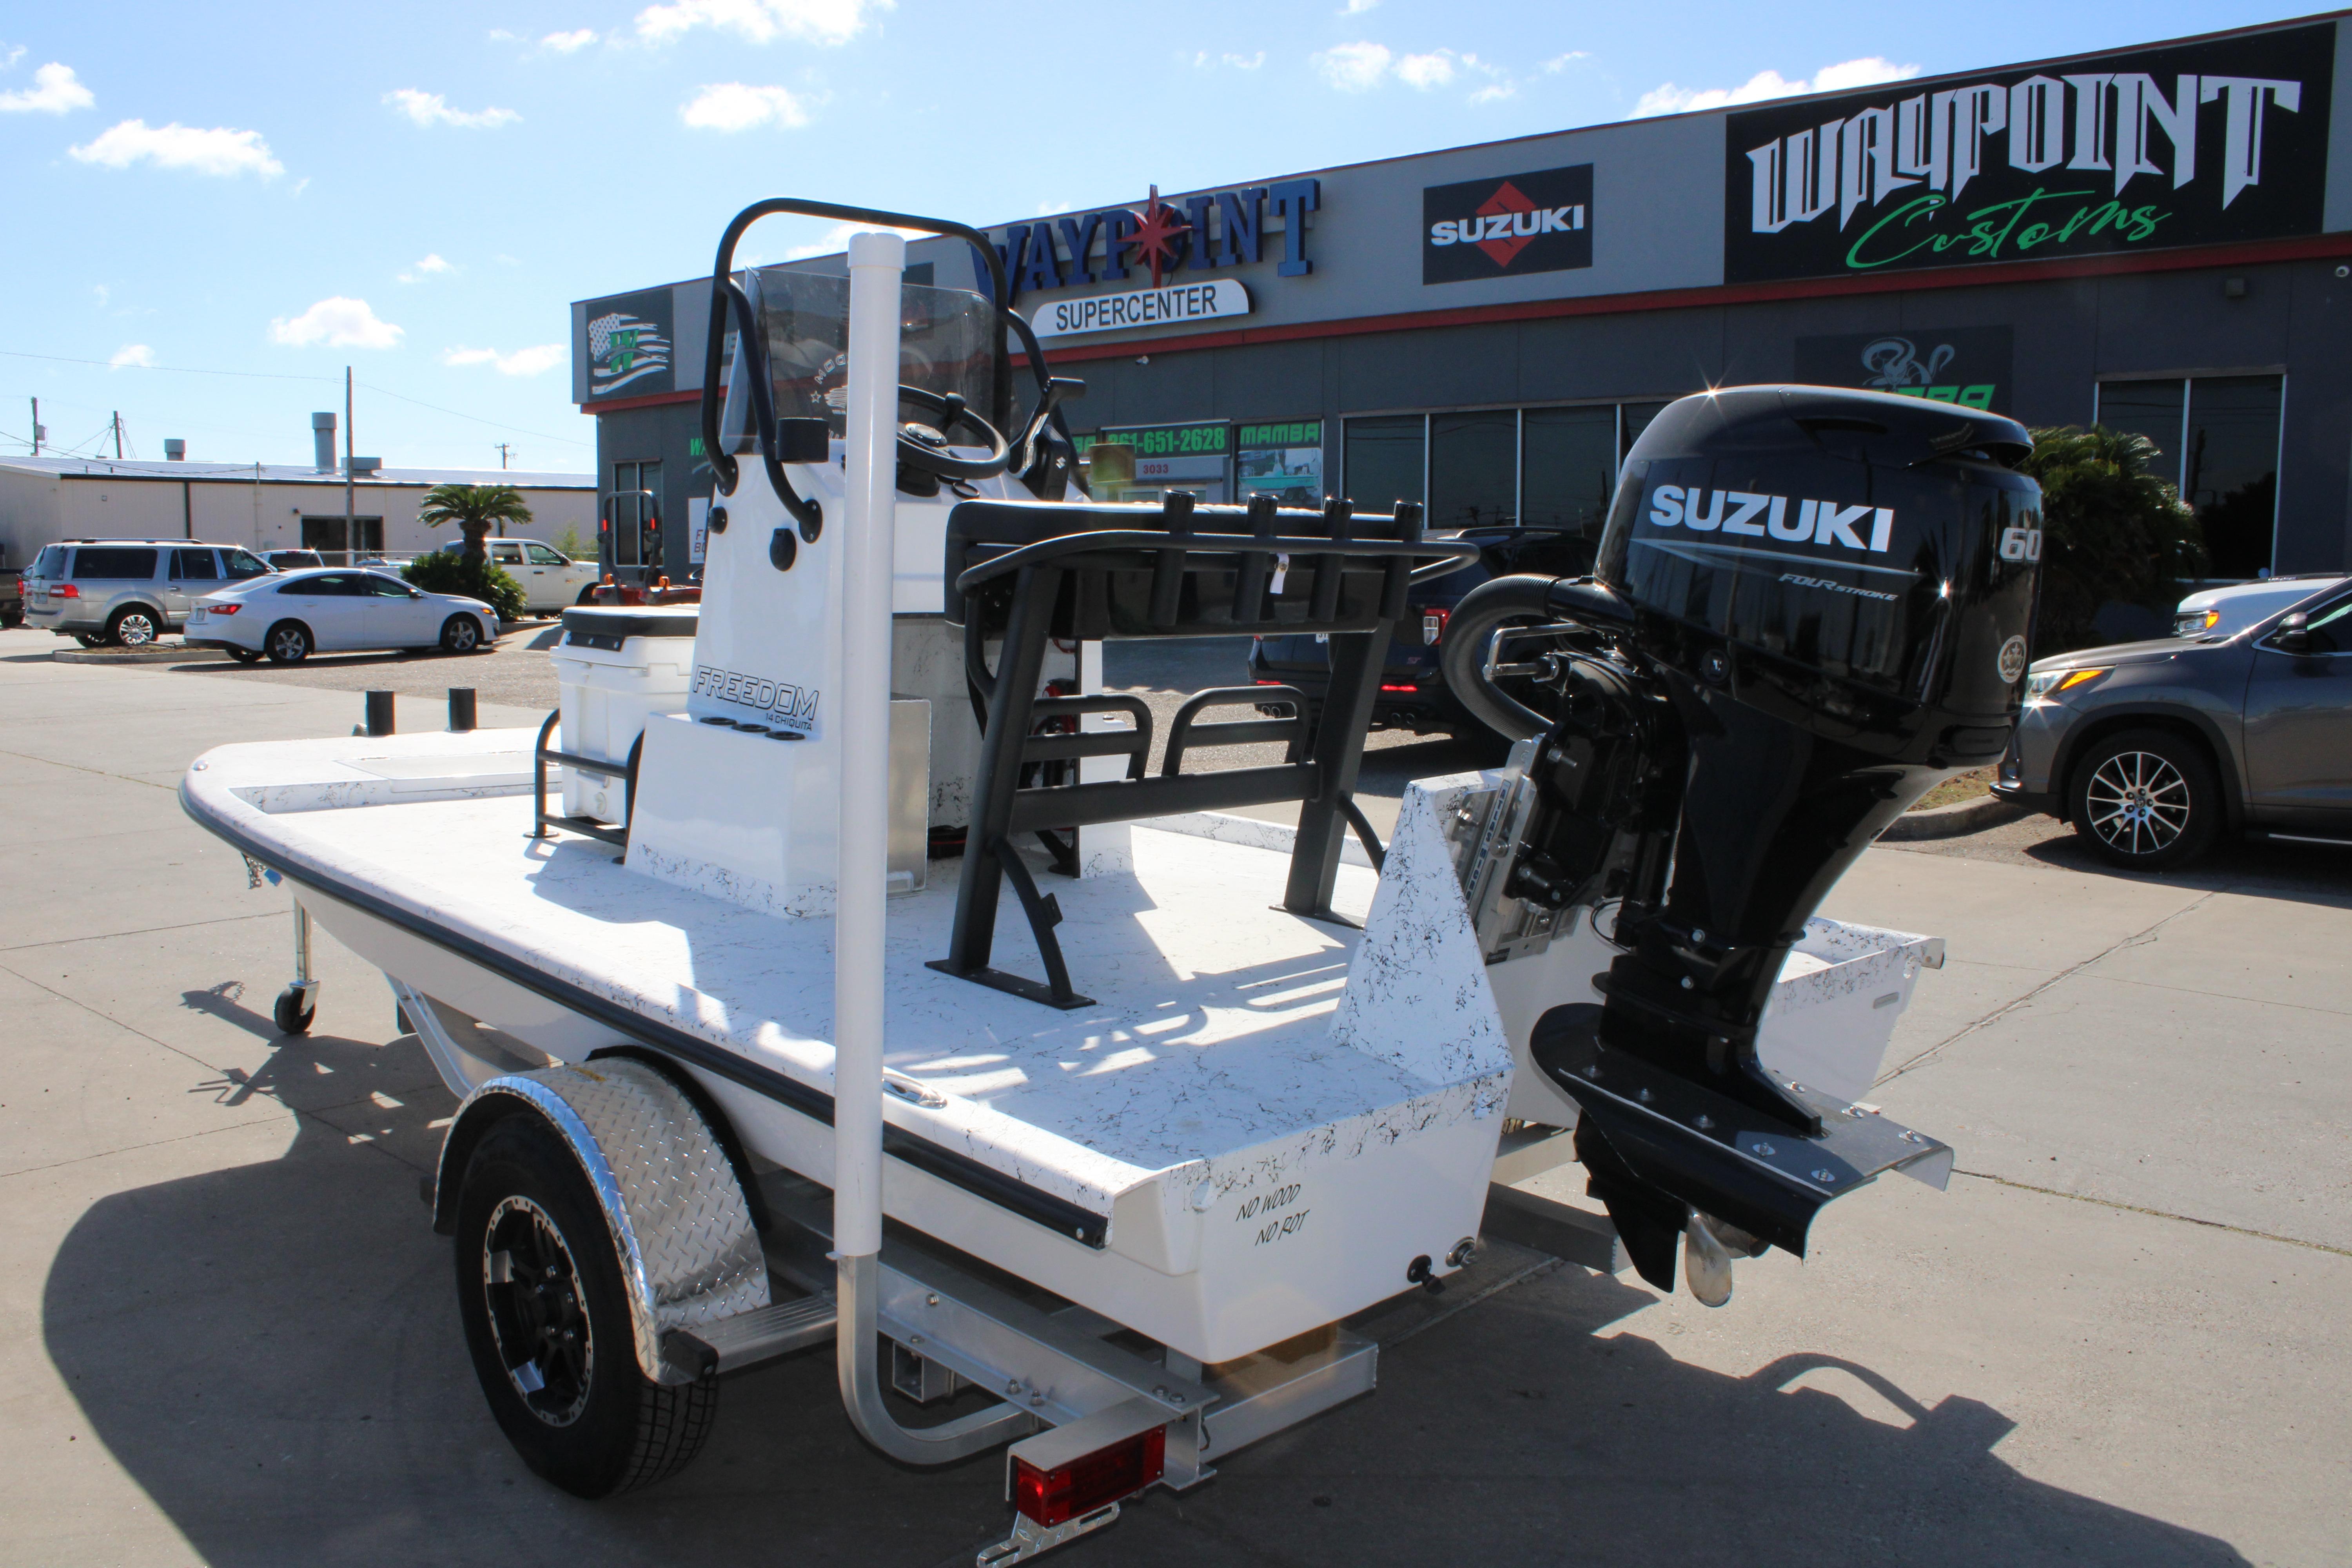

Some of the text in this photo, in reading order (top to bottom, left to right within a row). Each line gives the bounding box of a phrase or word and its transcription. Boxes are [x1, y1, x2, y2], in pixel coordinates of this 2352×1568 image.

[1746, 73, 2301, 233] WAYPOINT
[967, 179, 1321, 306] WAYPOINT
[1431, 203, 1584, 247] SUZUKI
[1846, 187, 2172, 268] Customs
[1056, 285, 1217, 332] SUPERCENTER
[1240, 423, 1319, 445] MAMBA
[1143, 464, 1169, 474] 3033
[1650, 485, 1894, 552] SUZUKI
[1999, 527, 2042, 561] 60
[693, 665, 819, 721] FREEDOM
[766, 712, 812, 731] 14 CHIQUITA
[1486, 789, 1506, 842] ATLAS
[1236, 1183, 1301, 1221] NO WOOD
[1255, 1209, 1310, 1246] NO ROT
